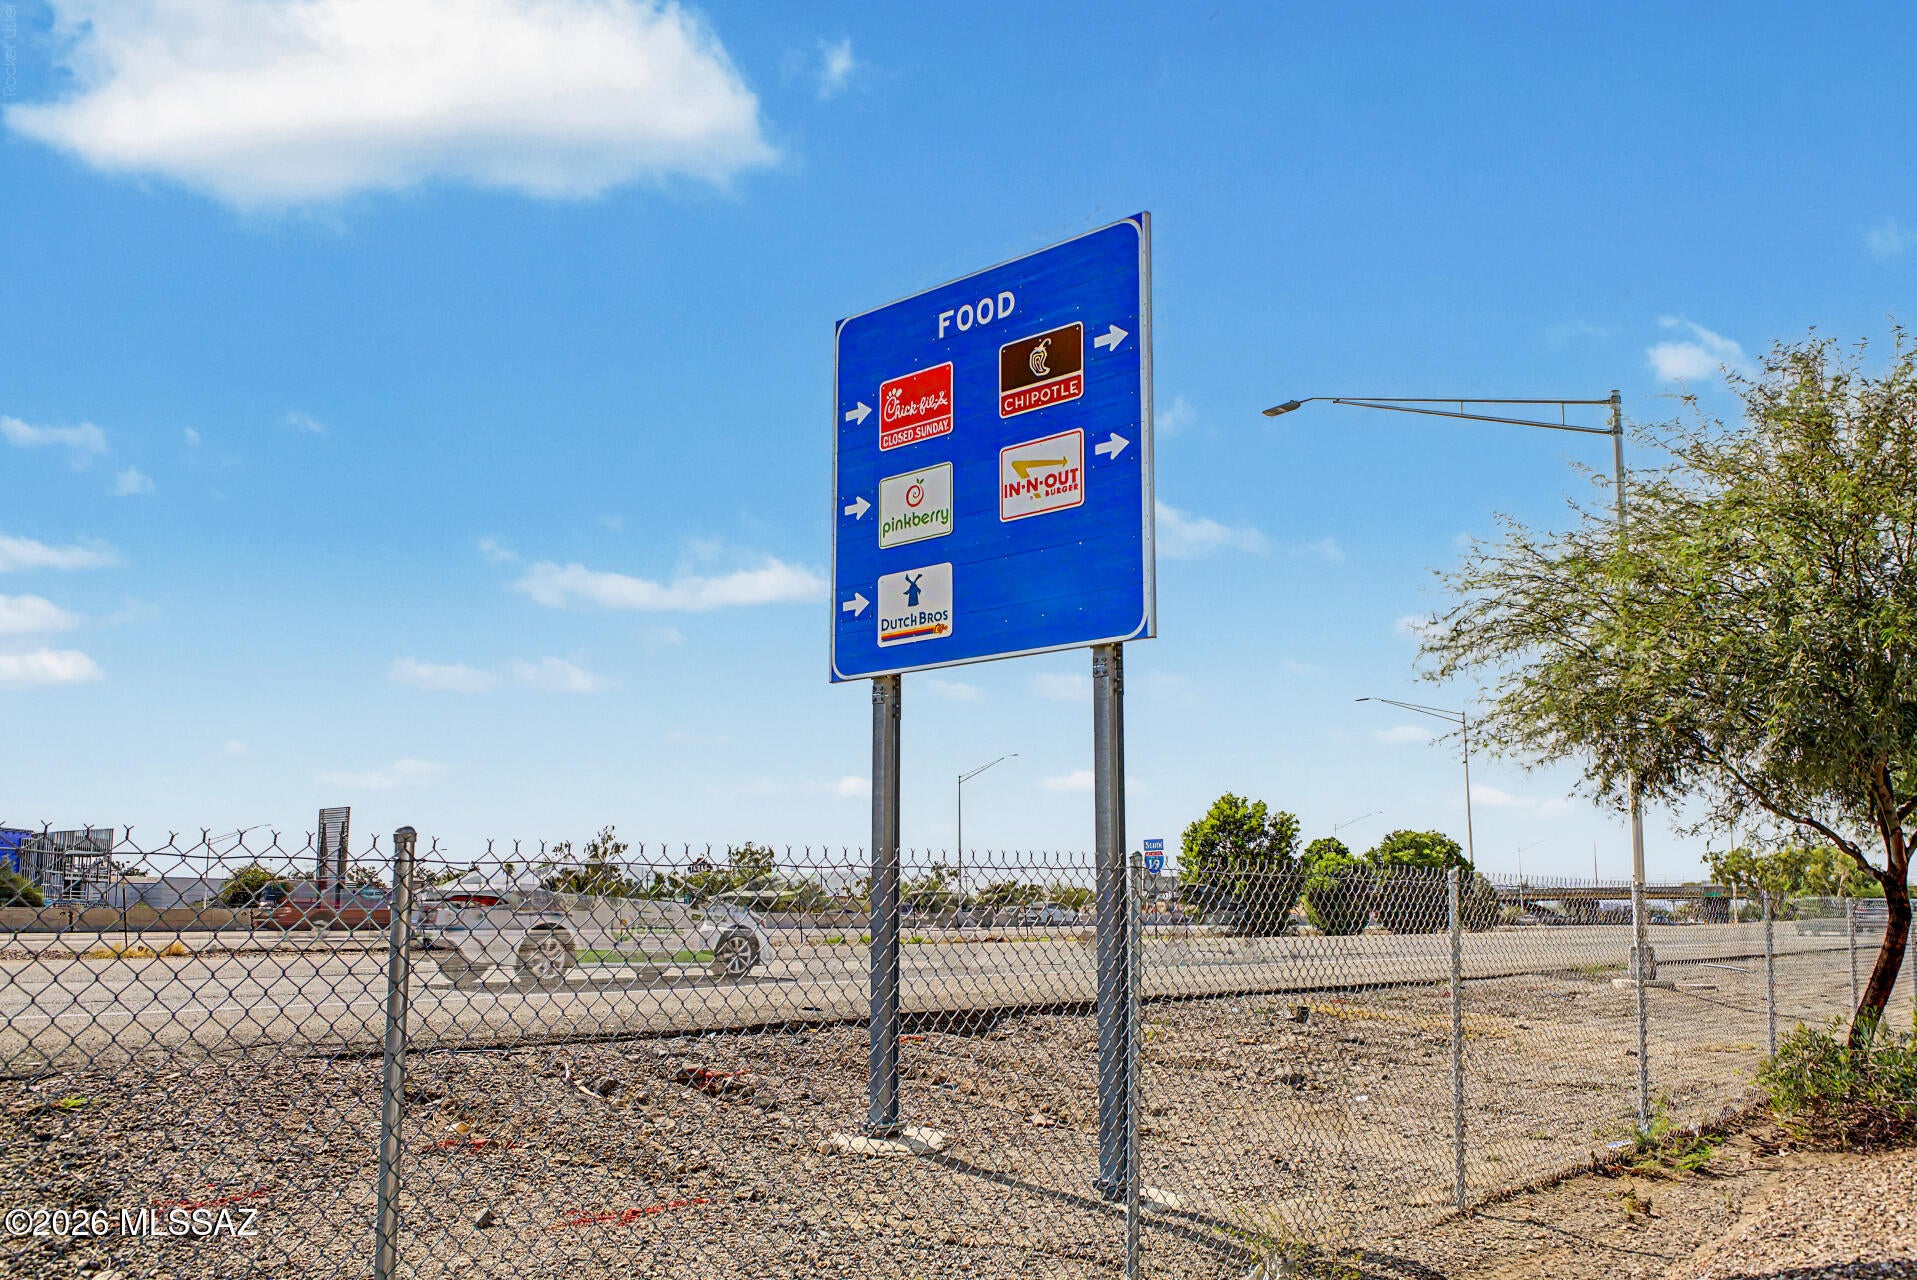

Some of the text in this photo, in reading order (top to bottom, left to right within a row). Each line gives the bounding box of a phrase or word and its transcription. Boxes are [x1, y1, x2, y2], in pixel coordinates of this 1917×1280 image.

[938, 291, 1016, 339] FOOD
[884, 389, 949, 422] Chick-fil-A
[1004, 380, 1079, 411] CHIPOTLE
[883, 418, 949, 447] CLOSED SUNDAY
[1045, 483, 1079, 497] BURGER
[882, 508, 949, 539] pinkberry
[881, 612, 917, 632] DUTCH
[919, 609, 949, 625] BROS
